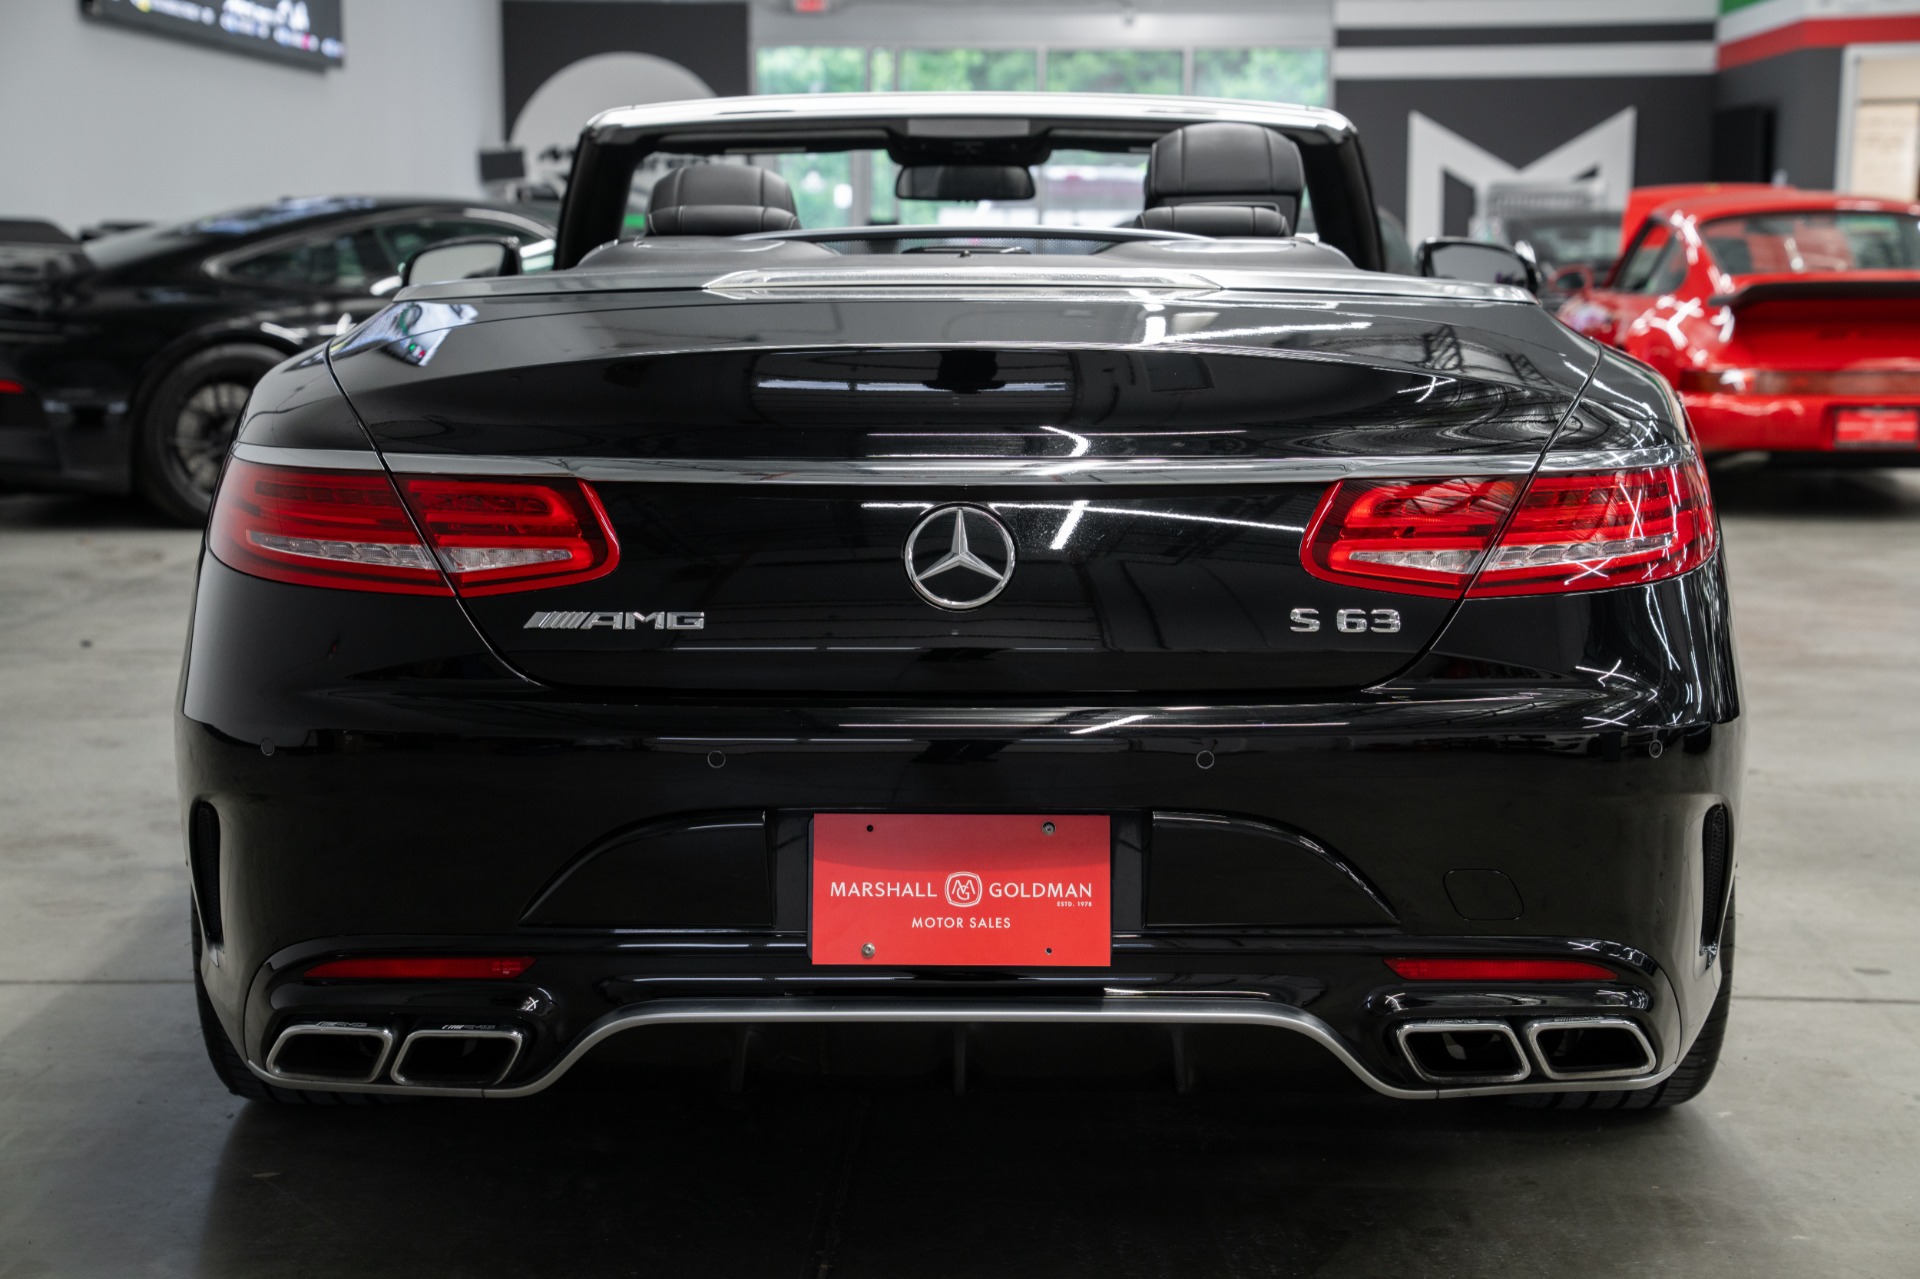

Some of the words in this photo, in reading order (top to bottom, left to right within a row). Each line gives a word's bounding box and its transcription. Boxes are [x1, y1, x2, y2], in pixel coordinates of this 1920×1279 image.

[578, 611, 705, 630] AMG
[1289, 608, 1321, 633] S
[1336, 608, 1402, 633] 63
[830, 882, 938, 898] MARSHALL
[989, 882, 1092, 898] GOLDMAN
[911, 917, 964, 928] MOTOR
[969, 917, 1011, 928] SALES
